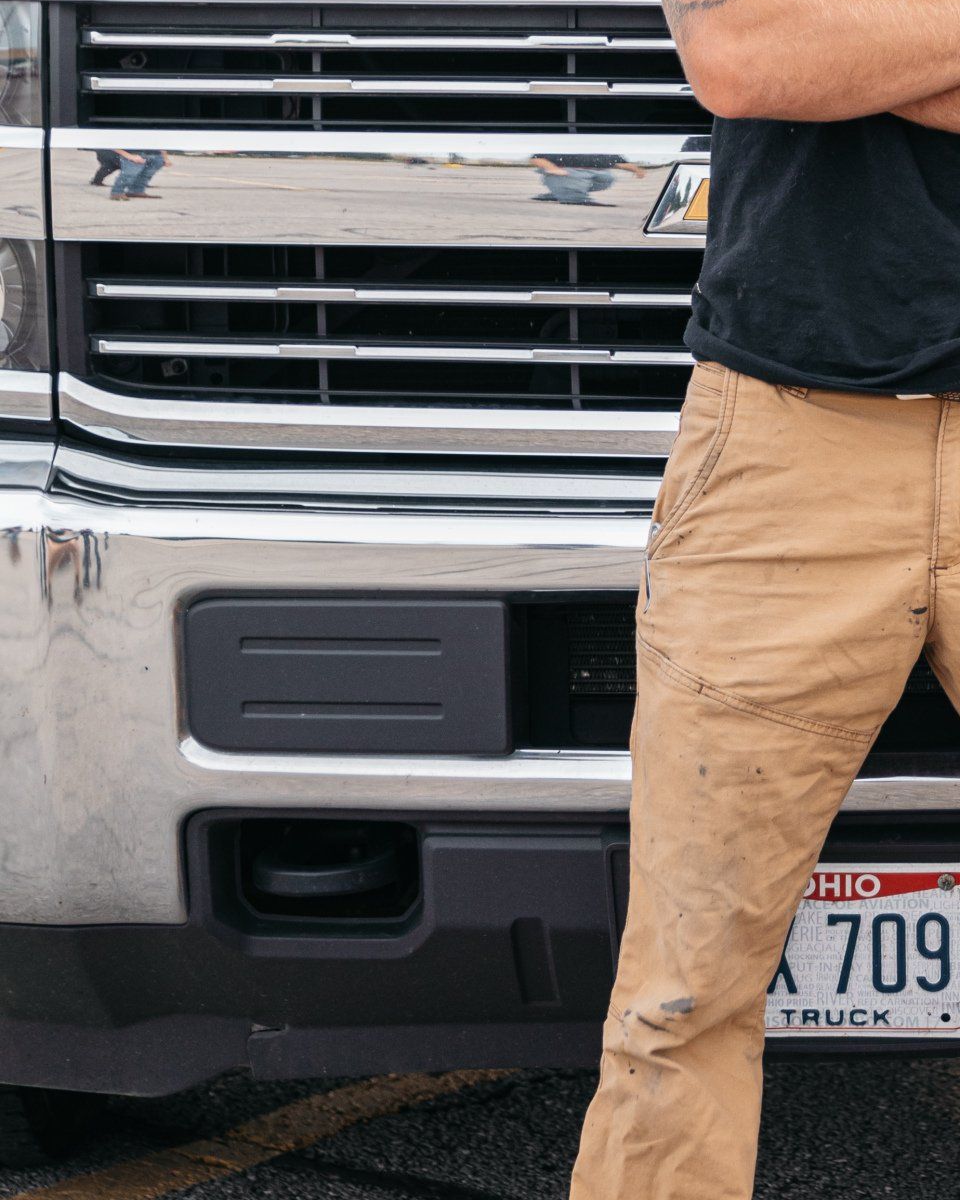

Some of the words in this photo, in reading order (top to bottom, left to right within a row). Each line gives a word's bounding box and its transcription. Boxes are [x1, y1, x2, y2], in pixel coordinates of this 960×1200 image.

[860, 899, 929, 909] AVIATION
[767, 998, 784, 1007] HIO
[881, 997, 939, 1006] CARNATION
[780, 1009, 890, 1026] TRUCK
